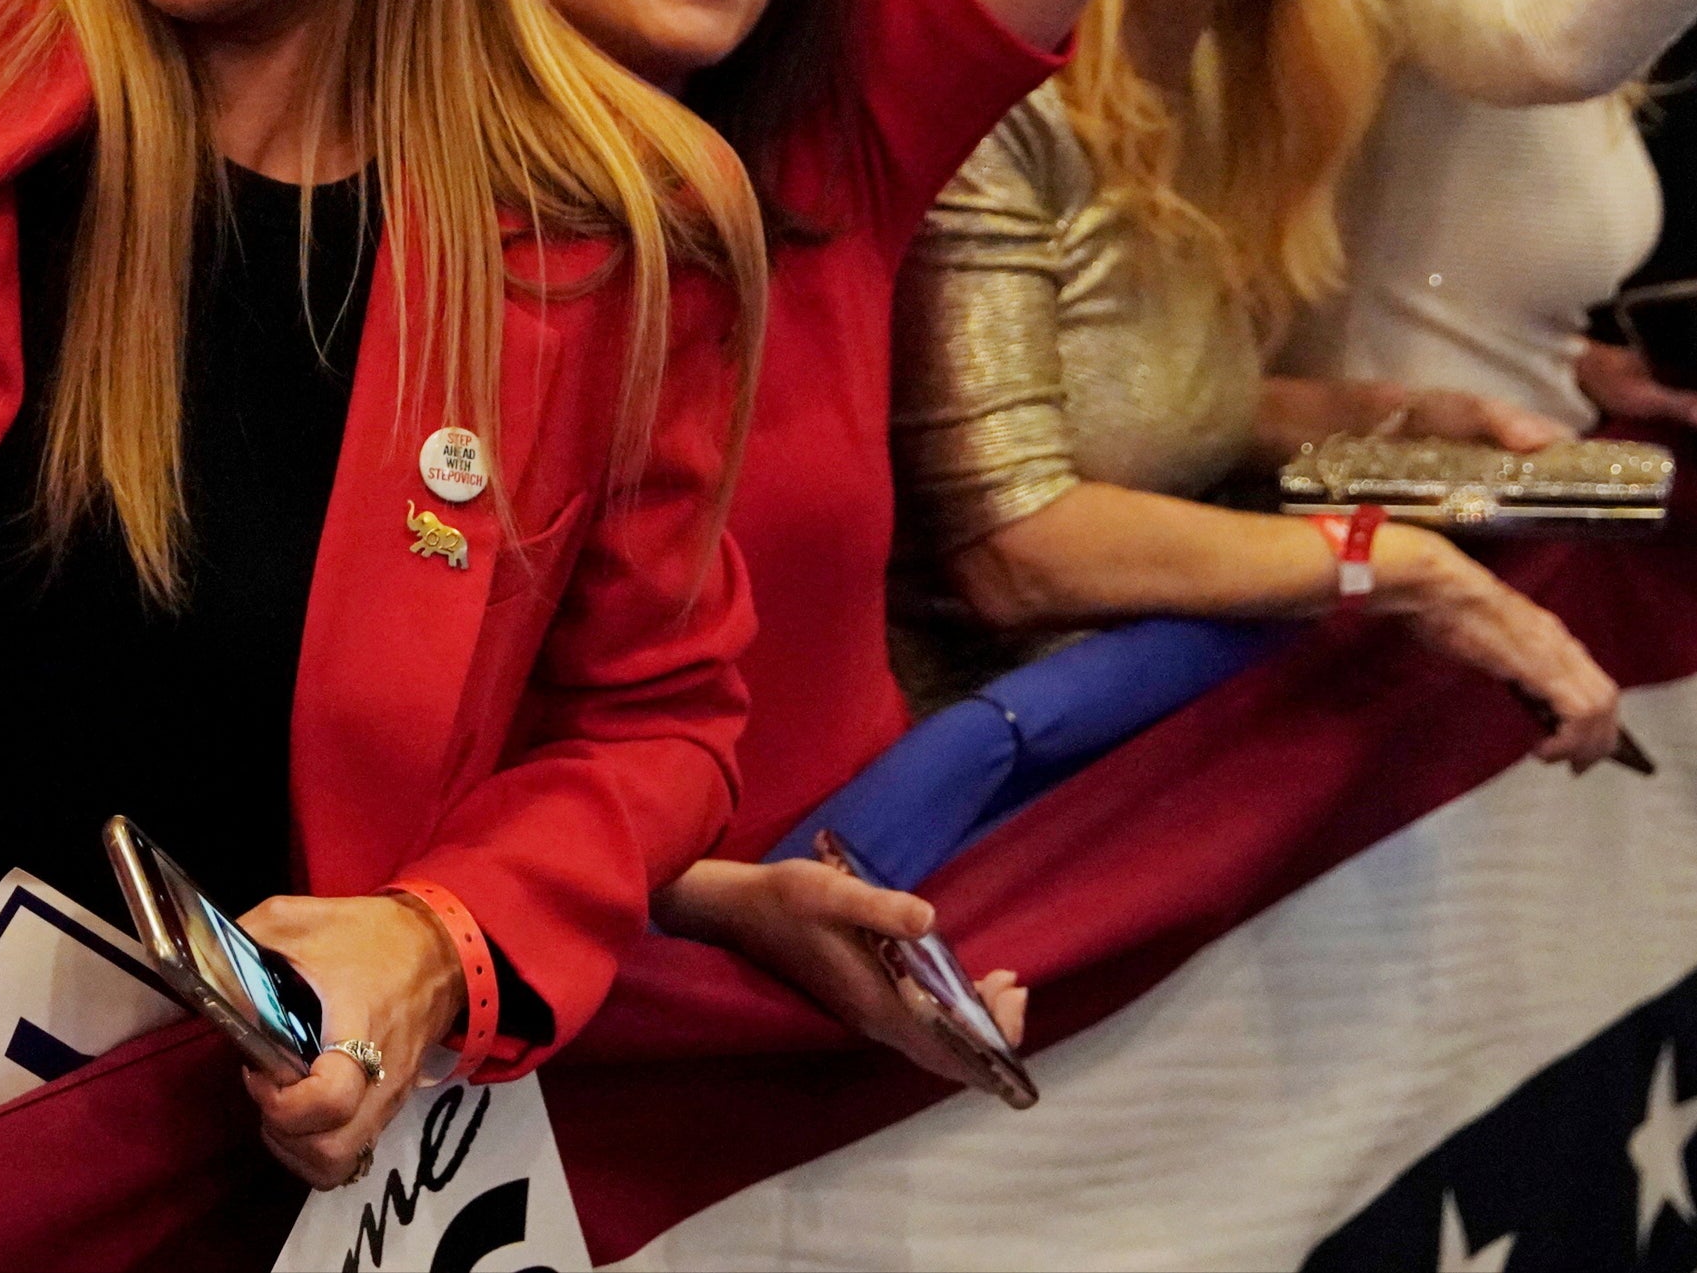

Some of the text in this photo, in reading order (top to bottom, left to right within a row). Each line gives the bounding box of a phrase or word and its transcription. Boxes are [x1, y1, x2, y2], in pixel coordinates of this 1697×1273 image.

[447, 432, 472, 447] STEP
[446, 458, 472, 472] WITH
[427, 467, 483, 487] STEPOVICH
